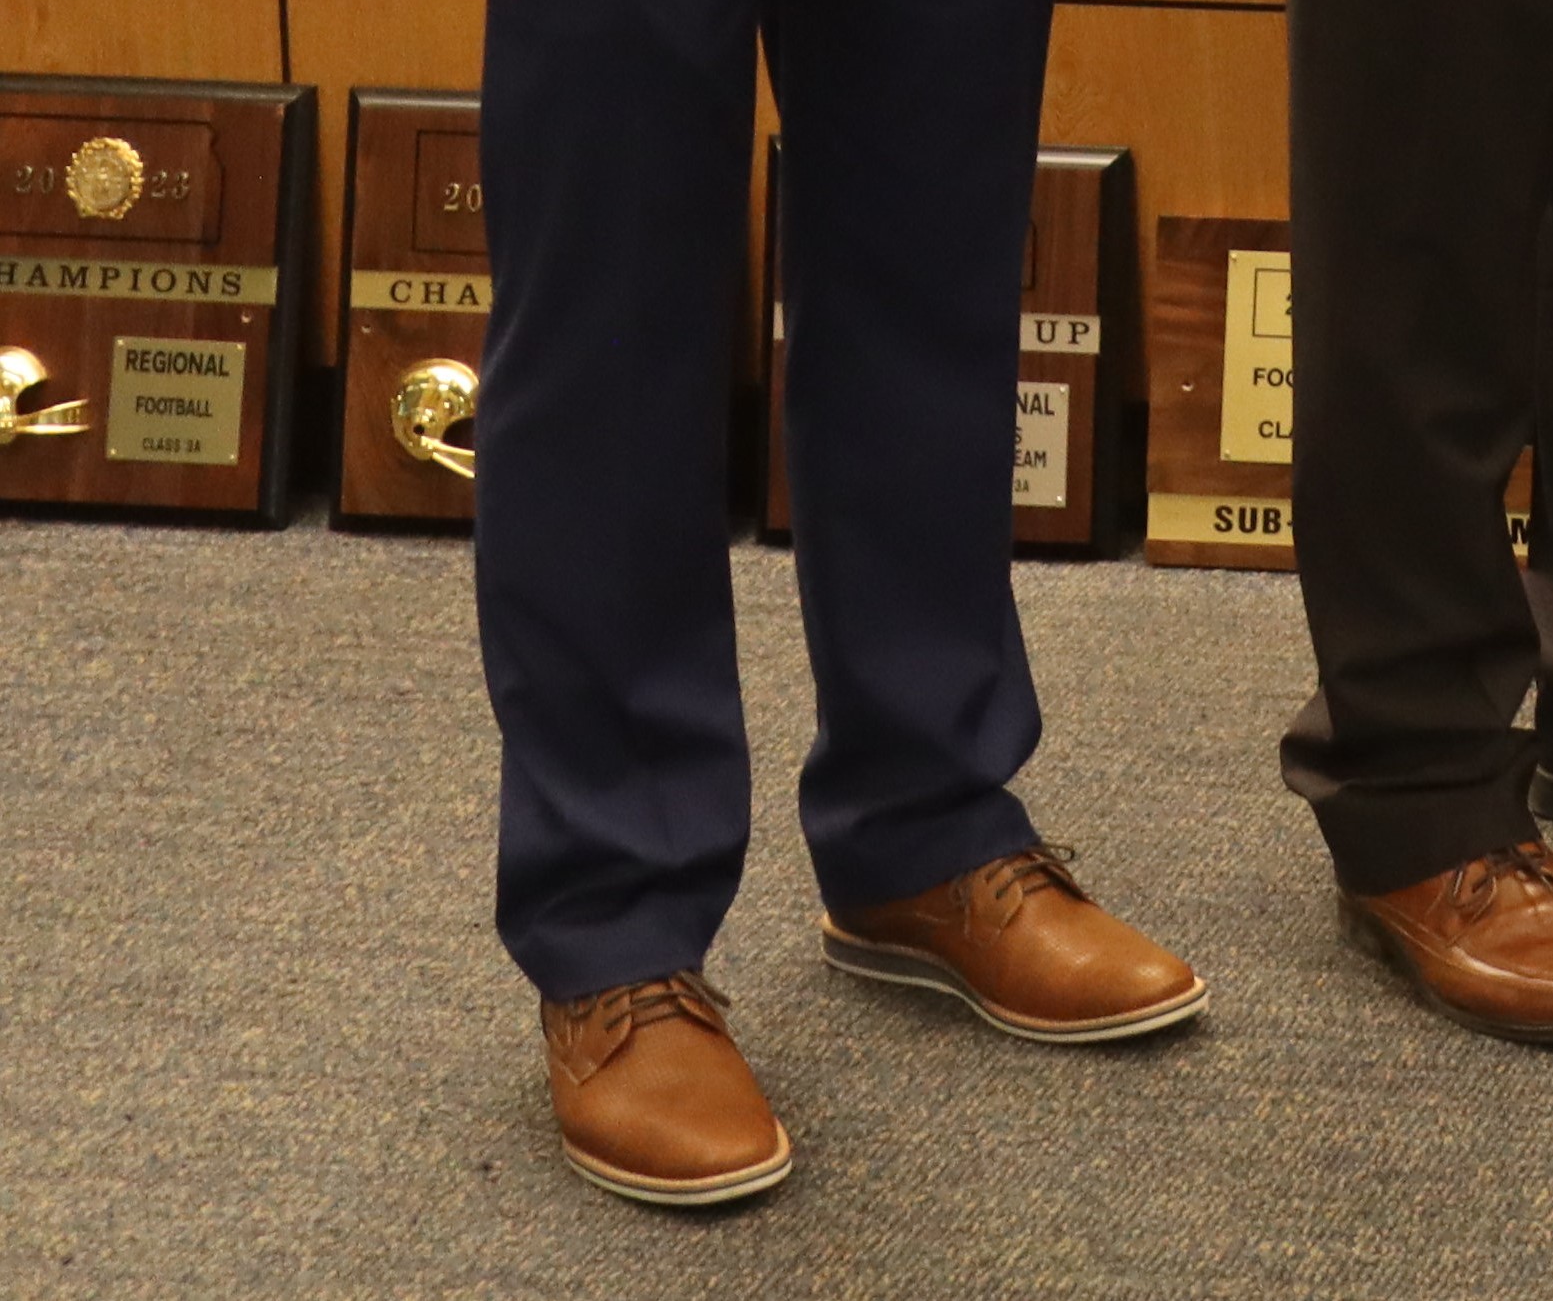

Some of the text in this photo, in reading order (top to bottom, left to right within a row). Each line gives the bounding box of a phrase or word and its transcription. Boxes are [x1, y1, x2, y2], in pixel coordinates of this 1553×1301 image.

[444, 182, 482, 212] 20
[389, 279, 493, 306] CHA
[1034, 319, 1090, 345] UP
[125, 350, 230, 377] REGIONAL
[135, 395, 213, 418] FOOTBALL
[142, 436, 182, 453] CLASS
